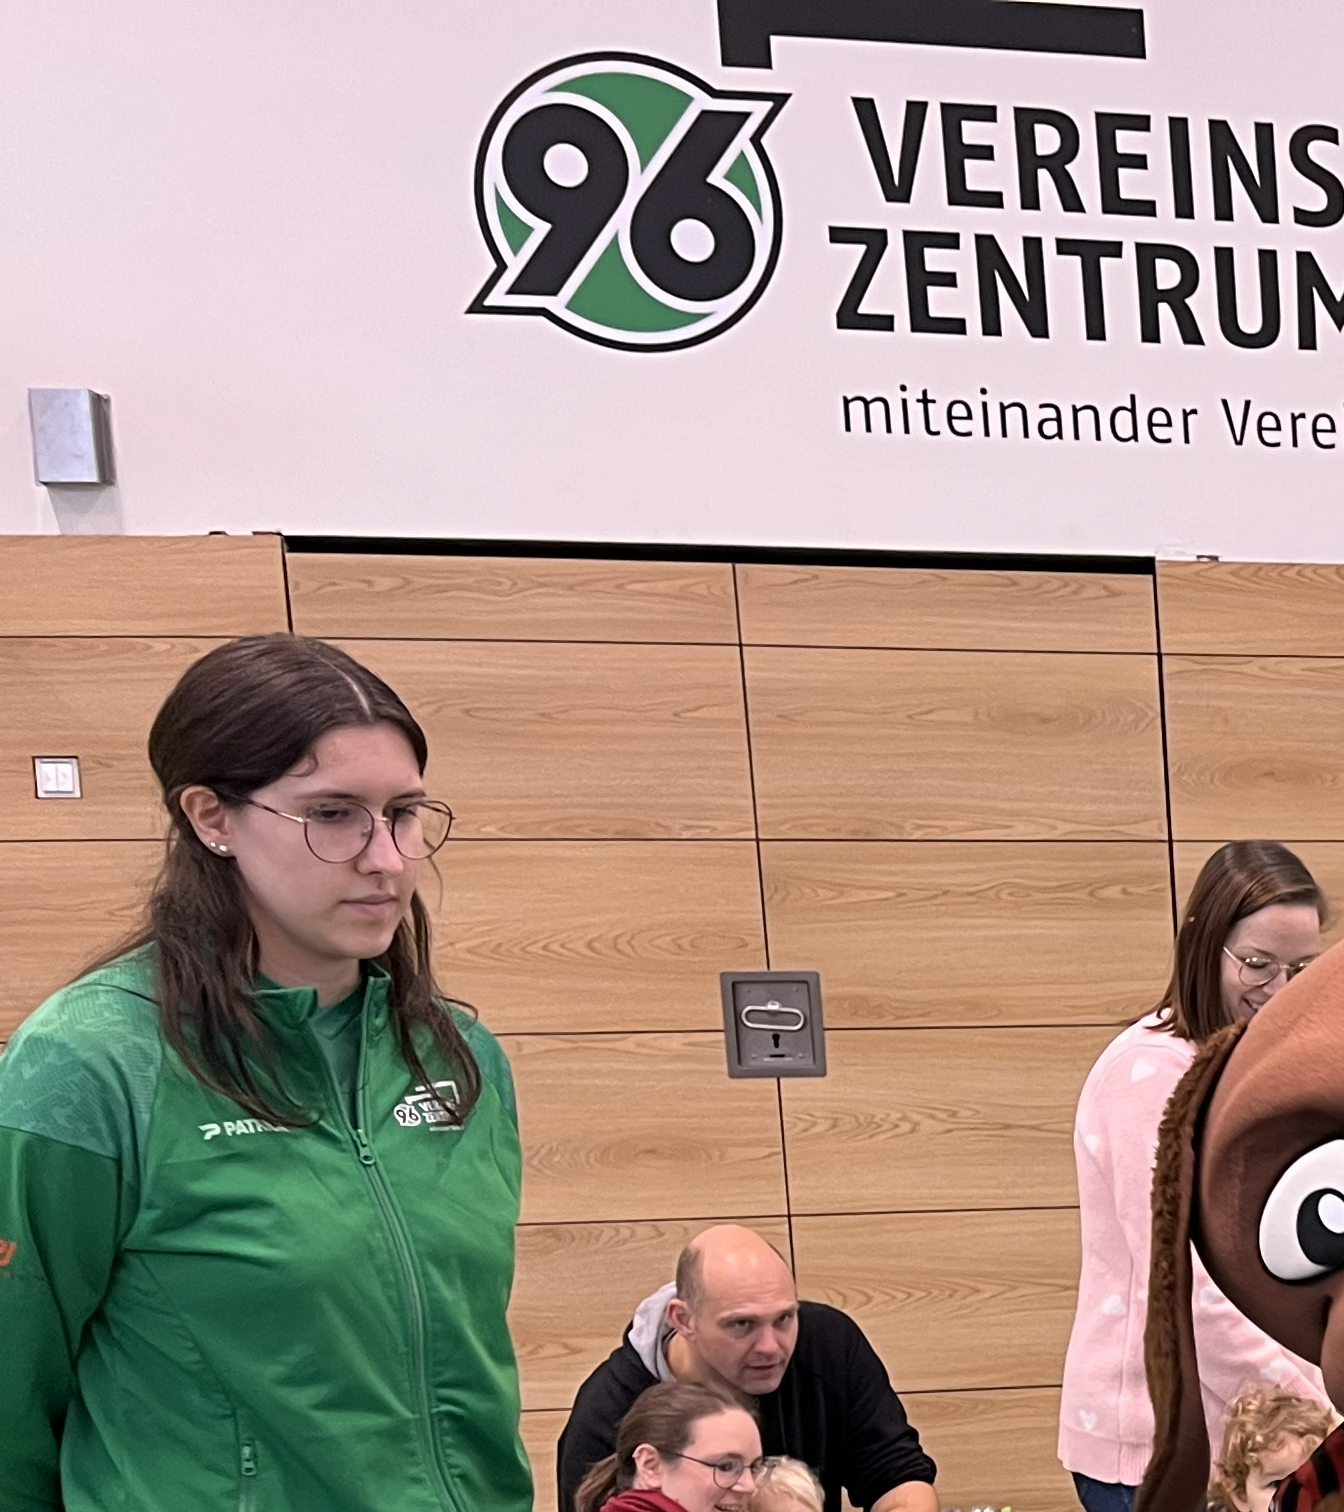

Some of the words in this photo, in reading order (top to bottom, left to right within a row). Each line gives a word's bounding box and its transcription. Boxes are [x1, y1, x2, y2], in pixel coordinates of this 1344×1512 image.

[488, 92, 768, 312] 96
[840, 384, 1200, 447] miteinander
[394, 1105, 421, 1125] 96
